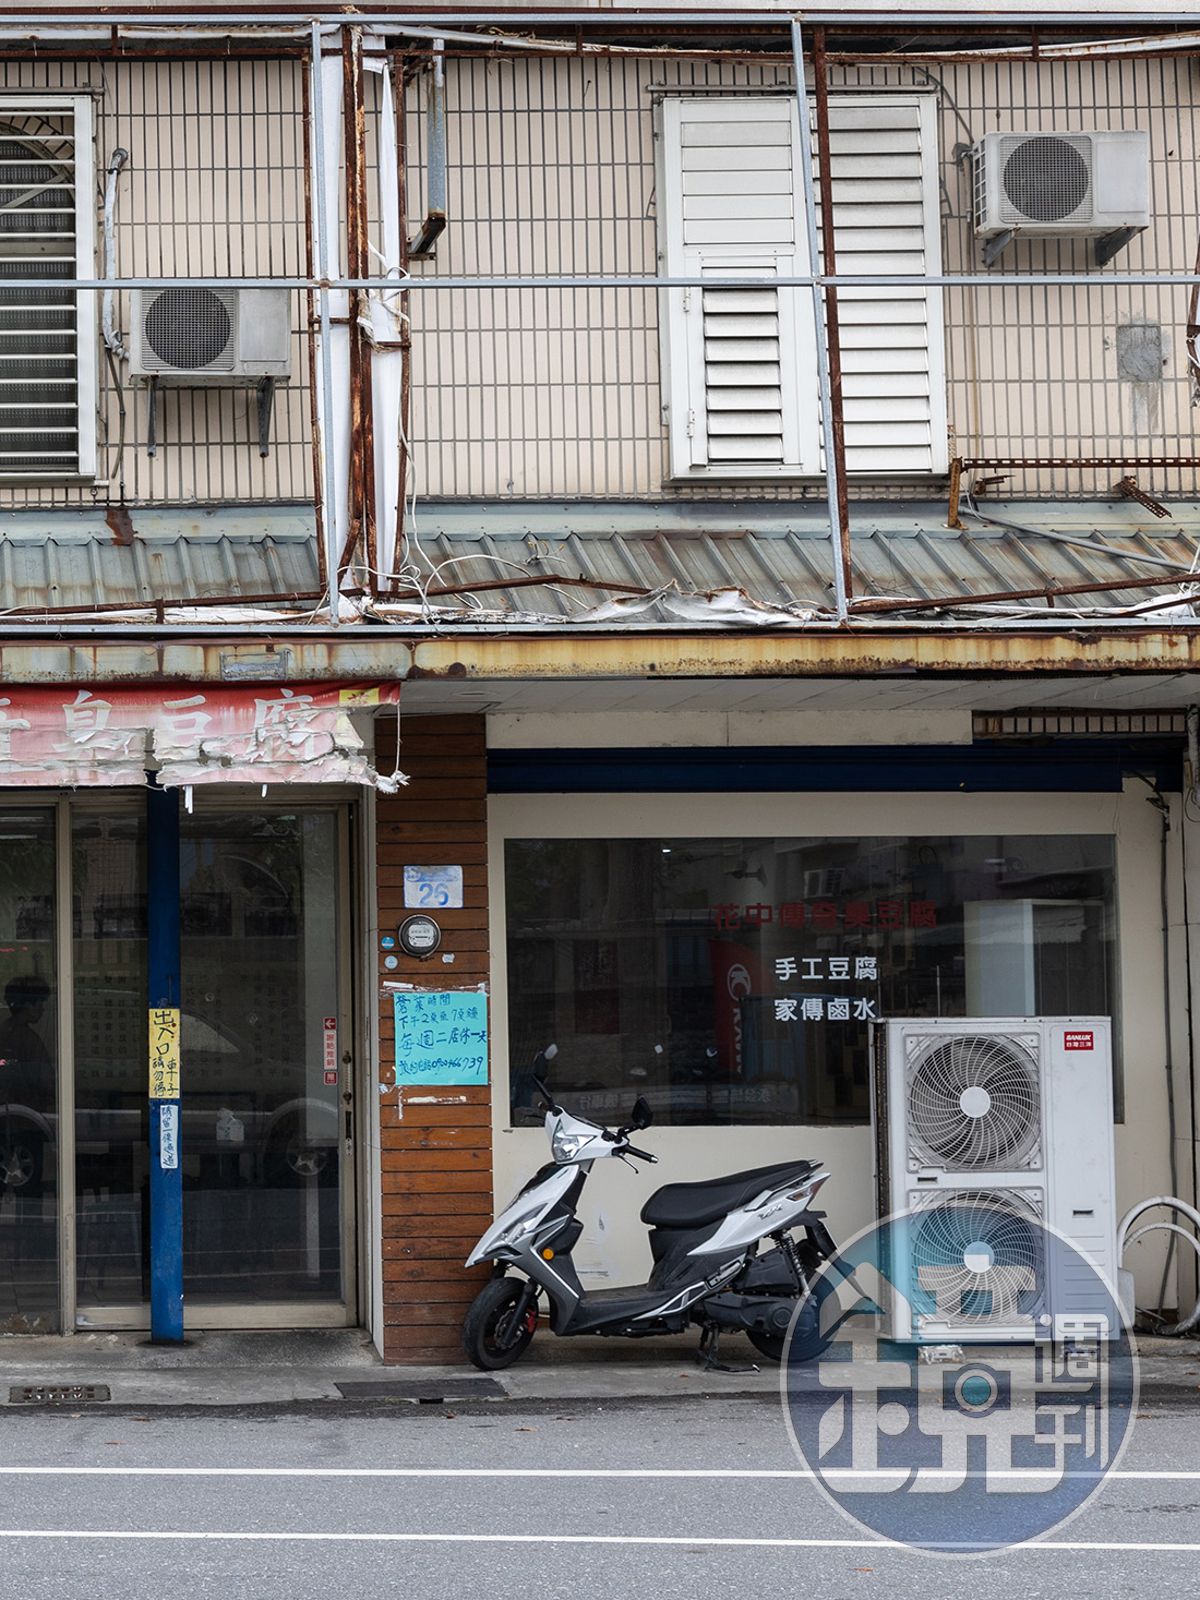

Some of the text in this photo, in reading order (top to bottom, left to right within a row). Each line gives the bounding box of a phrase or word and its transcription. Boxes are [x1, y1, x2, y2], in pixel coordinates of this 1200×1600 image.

[714, 901, 937, 930] 花中傳奇臭豆腐
[775, 956, 878, 981] 手工豆腐
[774, 997, 877, 1022] 家傳鹵水
[153, 1010, 175, 1056] 出入口
